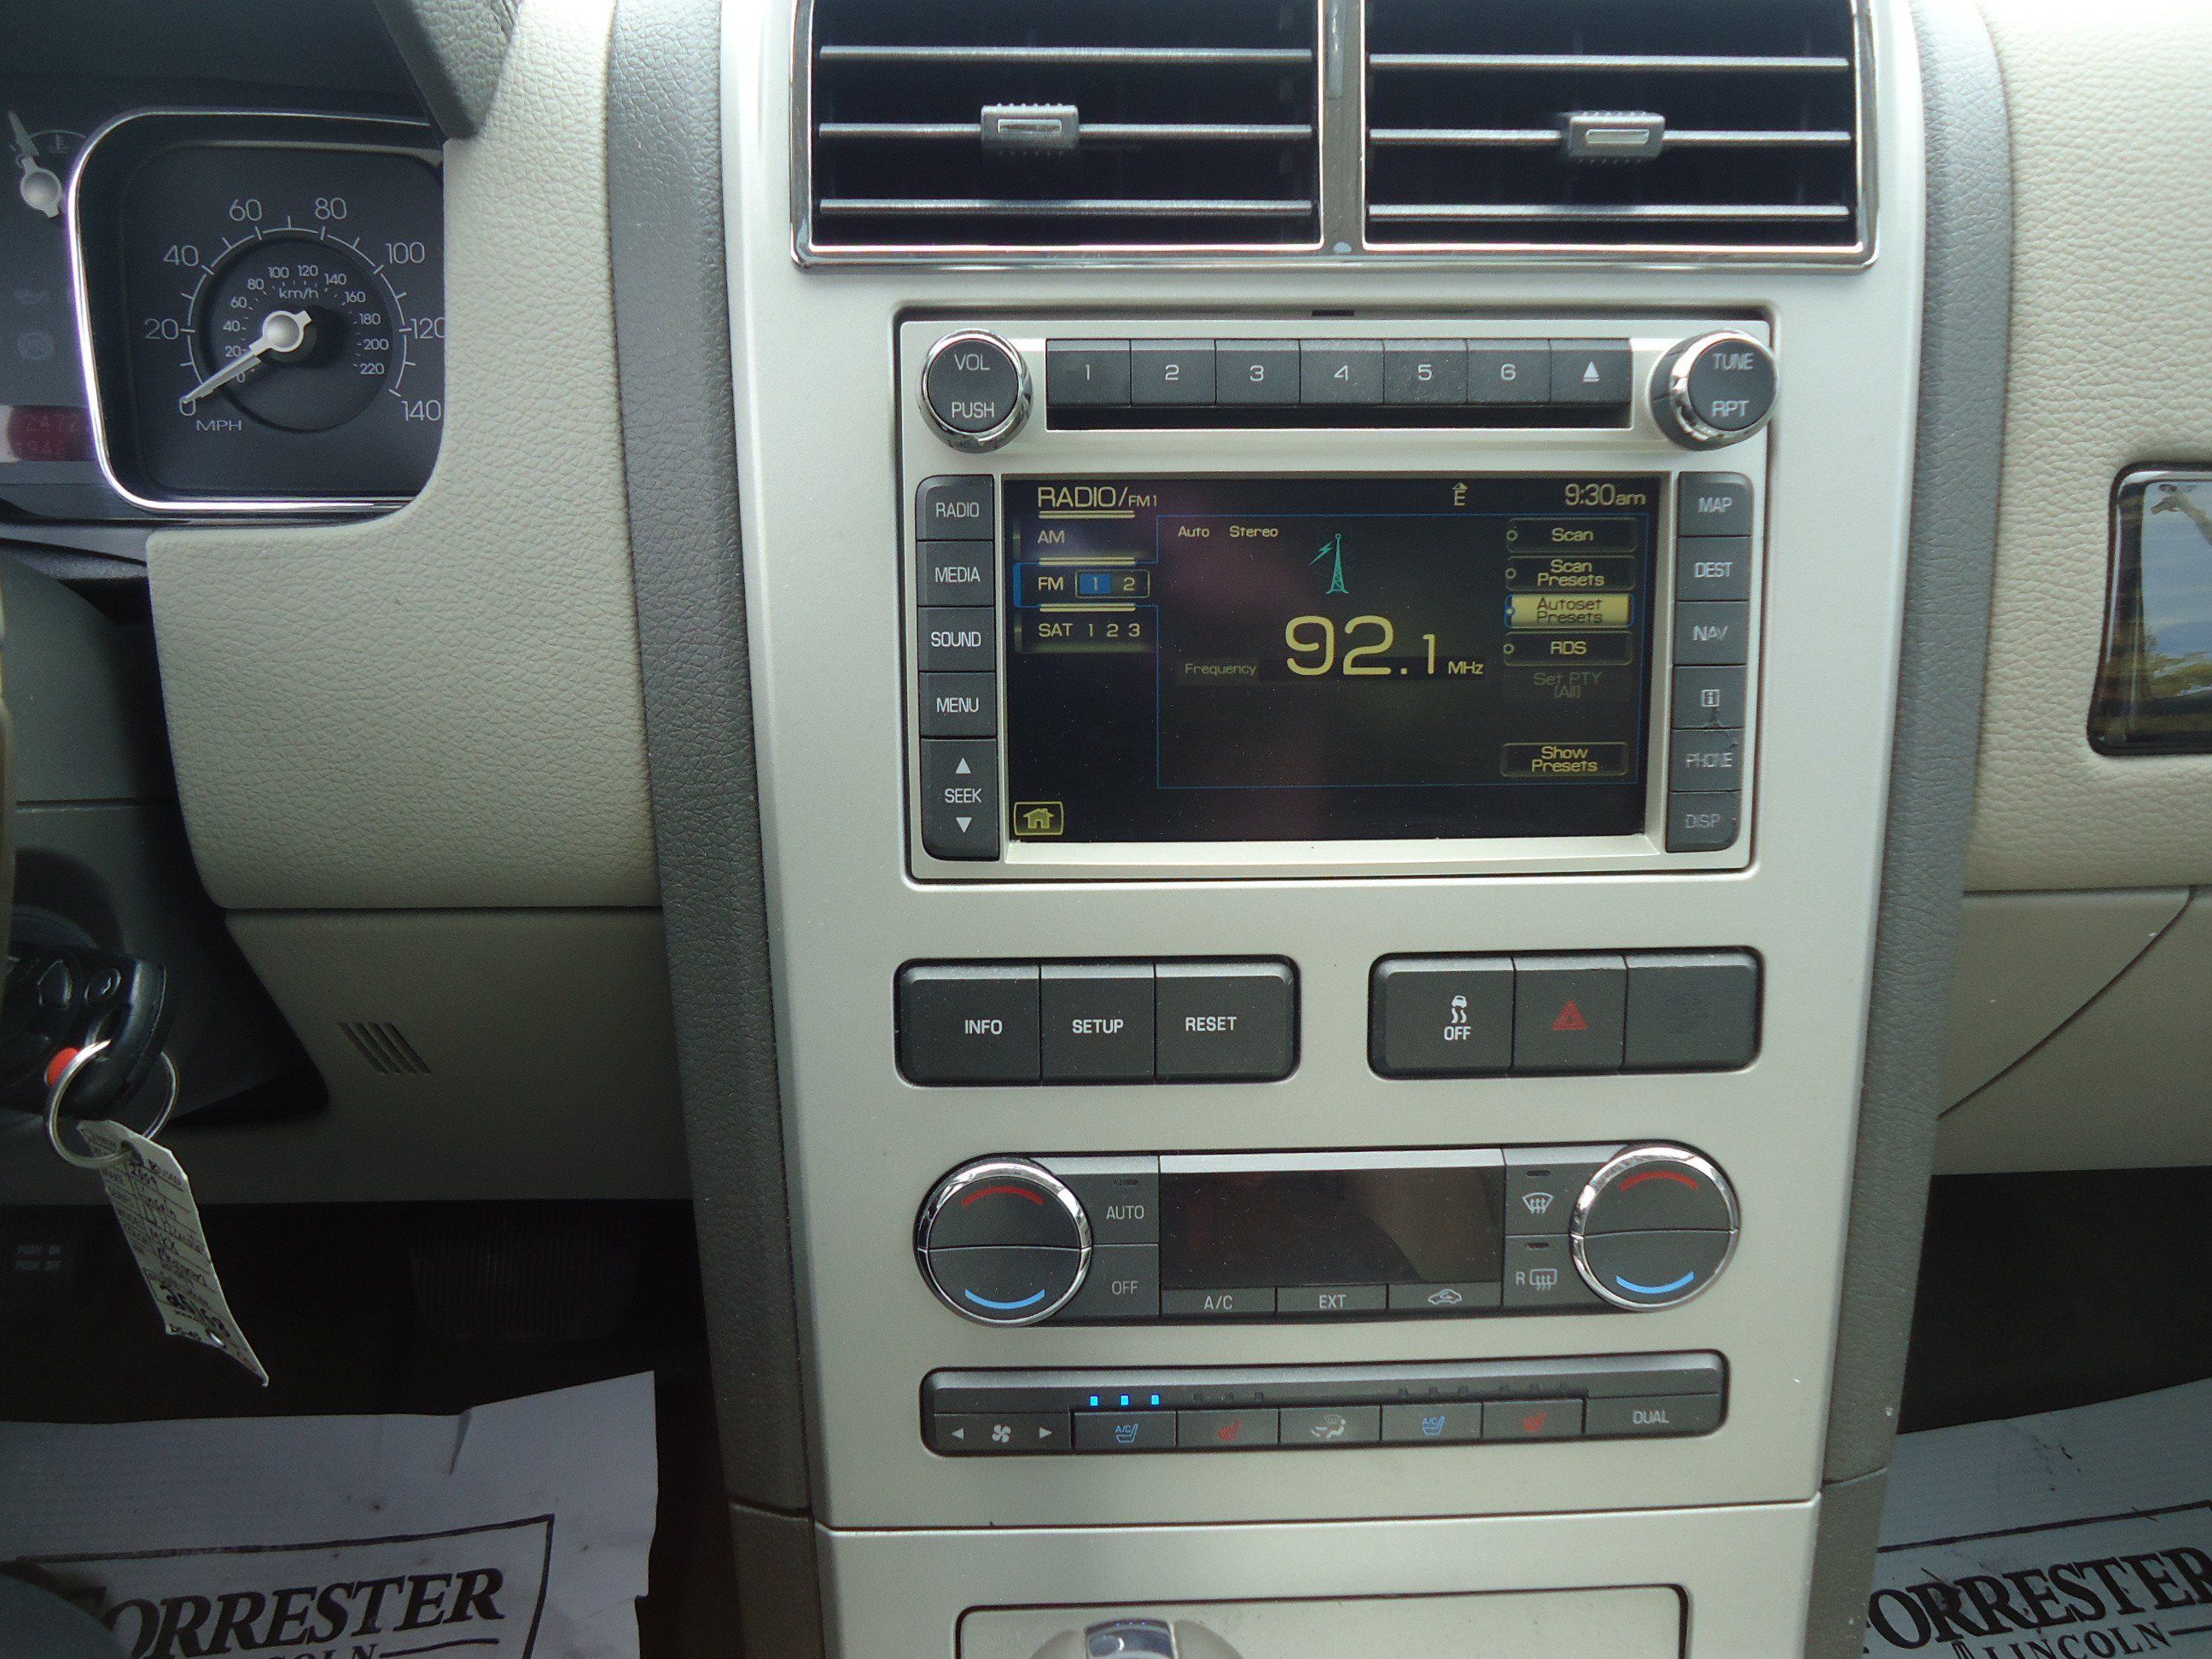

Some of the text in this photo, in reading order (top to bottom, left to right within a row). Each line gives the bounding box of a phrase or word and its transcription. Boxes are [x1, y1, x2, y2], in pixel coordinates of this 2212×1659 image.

[229, 198, 263, 222] 60
[314, 197, 347, 220] 80
[163, 245, 200, 267] 40
[384, 242, 426, 265] 100
[268, 266, 289, 279] 100
[297, 265, 319, 277] 120
[324, 272, 346, 285] 140
[247, 278, 265, 291] 80
[278, 287, 320, 300] km/h
[345, 290, 366, 304] 160
[230, 296, 247, 309] 60
[359, 312, 381, 325] 180
[144, 318, 179, 340] 20
[223, 320, 241, 333] 40
[224, 345, 242, 358] 20
[363, 338, 389, 351] 200
[954, 354, 990, 371] VOL
[1711, 352, 1754, 370] TUNE
[359, 363, 385, 375] 220
[1085, 365, 1091, 381] 1
[1165, 365, 1180, 381] 2
[1249, 366, 1265, 381] 3
[1334, 365, 1349, 381] 4
[1417, 364, 1433, 381] 5
[1500, 364, 1516, 381] 6
[401, 400, 442, 422] 140
[951, 401, 995, 418] PUSH
[1712, 400, 1749, 417] RPT
[196, 420, 242, 432] MPH
[1563, 483, 1647, 506] 9:30am
[935, 502, 980, 518] RADIO
[1698, 498, 1732, 513] MAP
[1037, 529, 1066, 544] AM
[1178, 525, 1278, 538] Auto Stereo
[1551, 527, 1594, 543] Scan
[1550, 559, 1593, 574] Scan
[1694, 562, 1733, 578] DEST
[934, 567, 981, 584] MEDIA
[1537, 573, 1605, 586] Presets
[1038, 576, 1064, 591] FM
[1122, 576, 1136, 591] 2
[1536, 597, 1602, 611] Autoset
[1536, 611, 1604, 626] Presets
[1038, 623, 1140, 637] SAT 1 2 3
[1692, 626, 1729, 641] NAV
[930, 632, 981, 648] SOUND
[1285, 615, 1484, 677] 92.1 MHz
[1551, 641, 1587, 655] RDS
[1185, 662, 1257, 677] Frequency
[1534, 672, 1602, 685] Set PTY
[936, 697, 980, 713] MENU
[1541, 746, 1588, 760] Show
[1532, 760, 1598, 773] Presets
[945, 788, 982, 803] SEEK
[1685, 814, 1720, 829] DISP
[964, 1020, 1003, 1035] INFO
[1072, 1019, 1124, 1034] SETUP
[1185, 1016, 1237, 1033] RESET
[1443, 1025, 1471, 1042] OFF
[1106, 1205, 1144, 1220] AUTO
[1516, 1272, 1525, 1286] R
[1111, 1281, 1138, 1295] OFF
[1203, 1295, 1233, 1311] A/C
[1319, 1295, 1346, 1309] EXT
[1633, 1411, 1670, 1426] DUAL
[1864, 1546, 2212, 1650] ORRESTER
